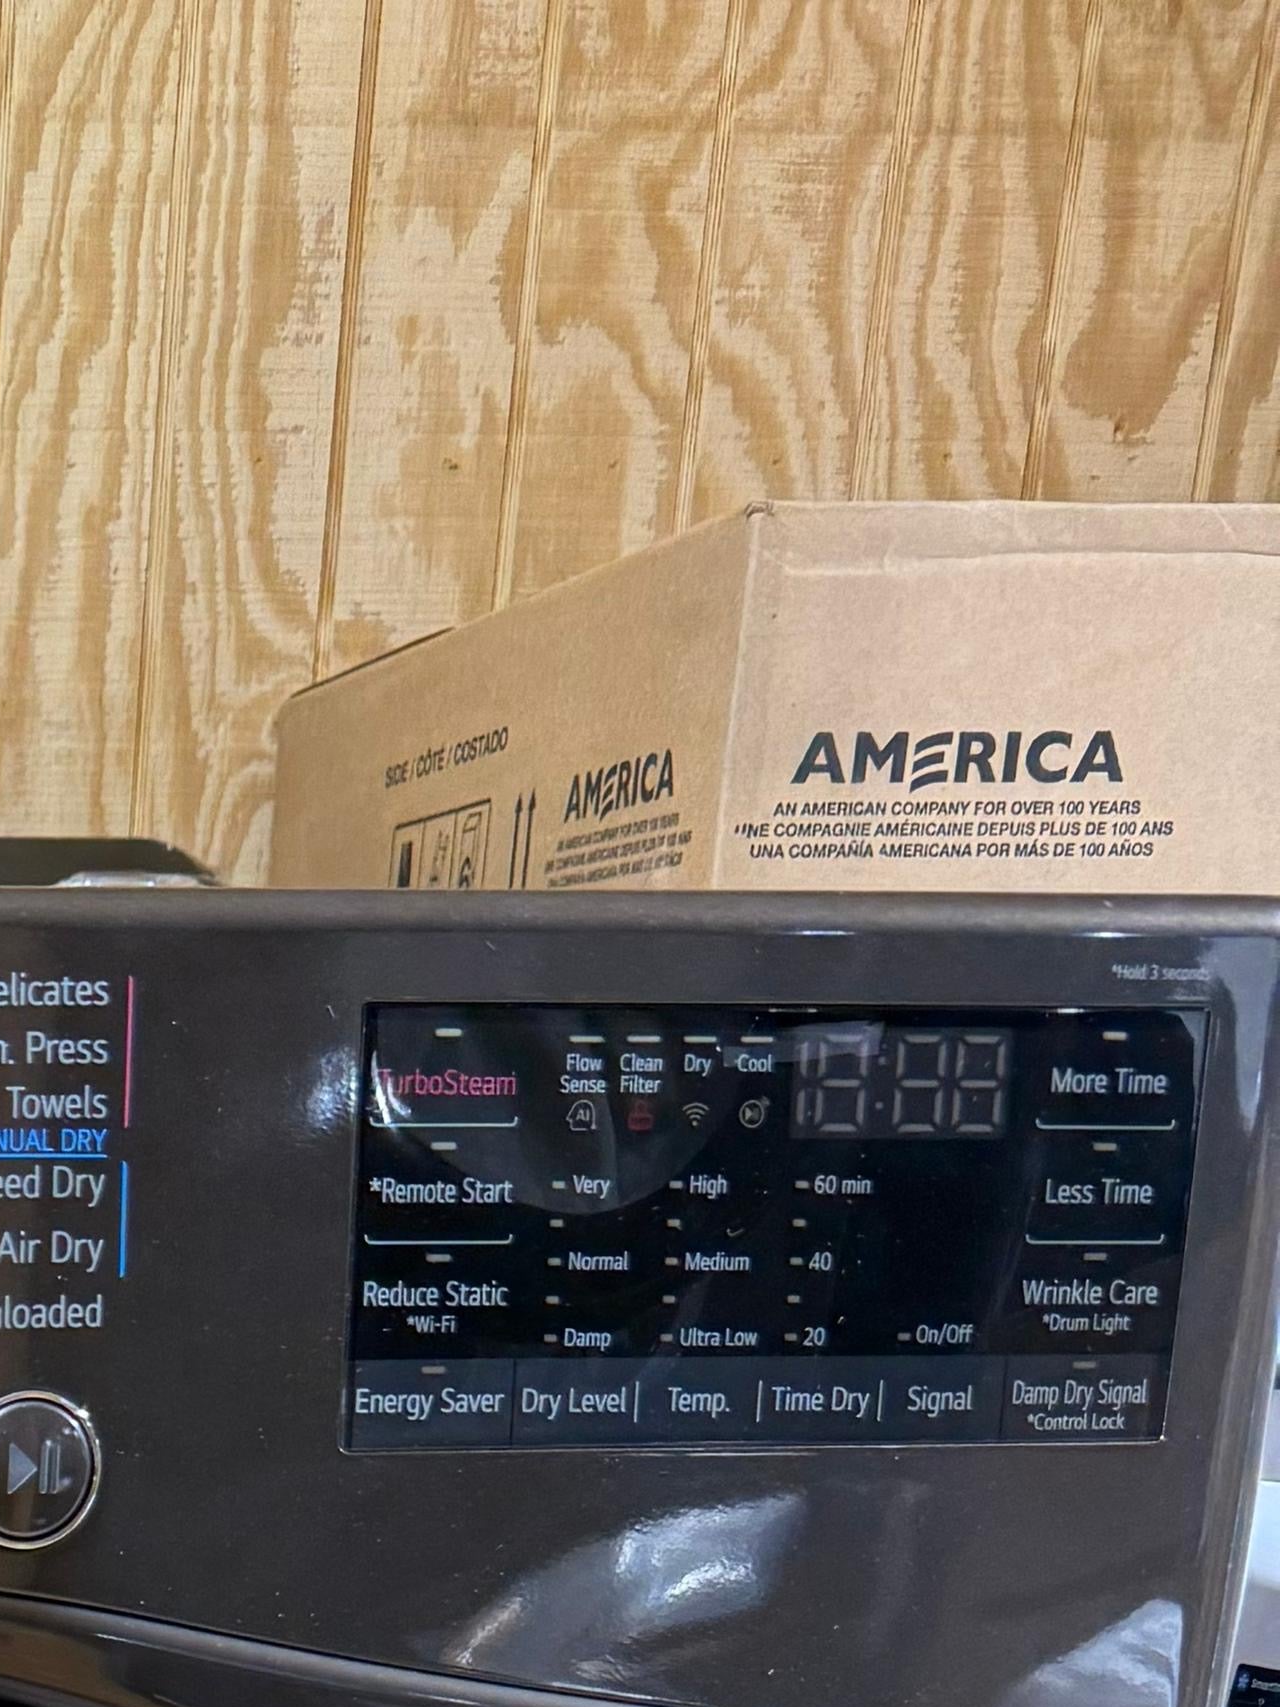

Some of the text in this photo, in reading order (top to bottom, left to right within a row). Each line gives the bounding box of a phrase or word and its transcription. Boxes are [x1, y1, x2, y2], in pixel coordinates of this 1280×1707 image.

[454, 726, 508, 766] COSTADO
[790, 730, 1123, 792] AMERICA
[564, 748, 674, 824] AMERICA
[773, 800, 1141, 817] AN AMERICAN COMPANY FOR OVER 100 YEARS
[773, 822, 871, 837] COMPAGNIE
[873, 819, 973, 836] AMÉRICAINE
[977, 822, 1035, 836] DEPUIS
[1039, 822, 1081, 835] PLUS
[1085, 821, 1107, 835] DE
[1111, 821, 1136, 835] 100
[1139, 821, 1174, 836] ANS
[749, 839, 1154, 859] UNA COMPAÑÍA AMERICANA POR MÁS DE 100 AÑOS
[26, 1031, 109, 1065] Press
[566, 1053, 602, 1072] Flow
[619, 1053, 663, 1072] Clean
[684, 1054, 711, 1076] Dry
[737, 1053, 772, 1073] Cool
[559, 1075, 607, 1094] Sense
[619, 1075, 661, 1094] Filter
[1051, 1067, 1168, 1094] More Time
[5, 1084, 108, 1120] Towels
[60, 1128, 108, 1152] DRY
[52, 1167, 105, 1207] Dry
[462, 1177, 513, 1203] Start
[573, 1175, 610, 1198] Very
[689, 1175, 727, 1199] High
[814, 1176, 871, 1194] 60 min
[1045, 1179, 1153, 1204] Less Time
[50, 1230, 104, 1271] Dry
[568, 1252, 629, 1271] Normal
[685, 1252, 749, 1271] Medium
[808, 1252, 832, 1270] 40
[363, 1280, 510, 1307] Reduce Static
[1022, 1278, 1159, 1305] Wrinkle Care
[915, 1325, 973, 1346] On/Off
[1093, 1313, 1131, 1335] Light
[564, 1329, 611, 1351] Damp
[680, 1328, 757, 1346] Ultra Low
[803, 1328, 825, 1346] 20
[355, 1388, 504, 1419] Energy Saver
[521, 1387, 626, 1419] Dry Level
[668, 1387, 730, 1418] Temp.
[772, 1386, 869, 1417] Time Dry
[907, 1385, 973, 1417] Signal
[1012, 1378, 1148, 1411] Damp Dry Signal
[1091, 1412, 1125, 1430] Lock
